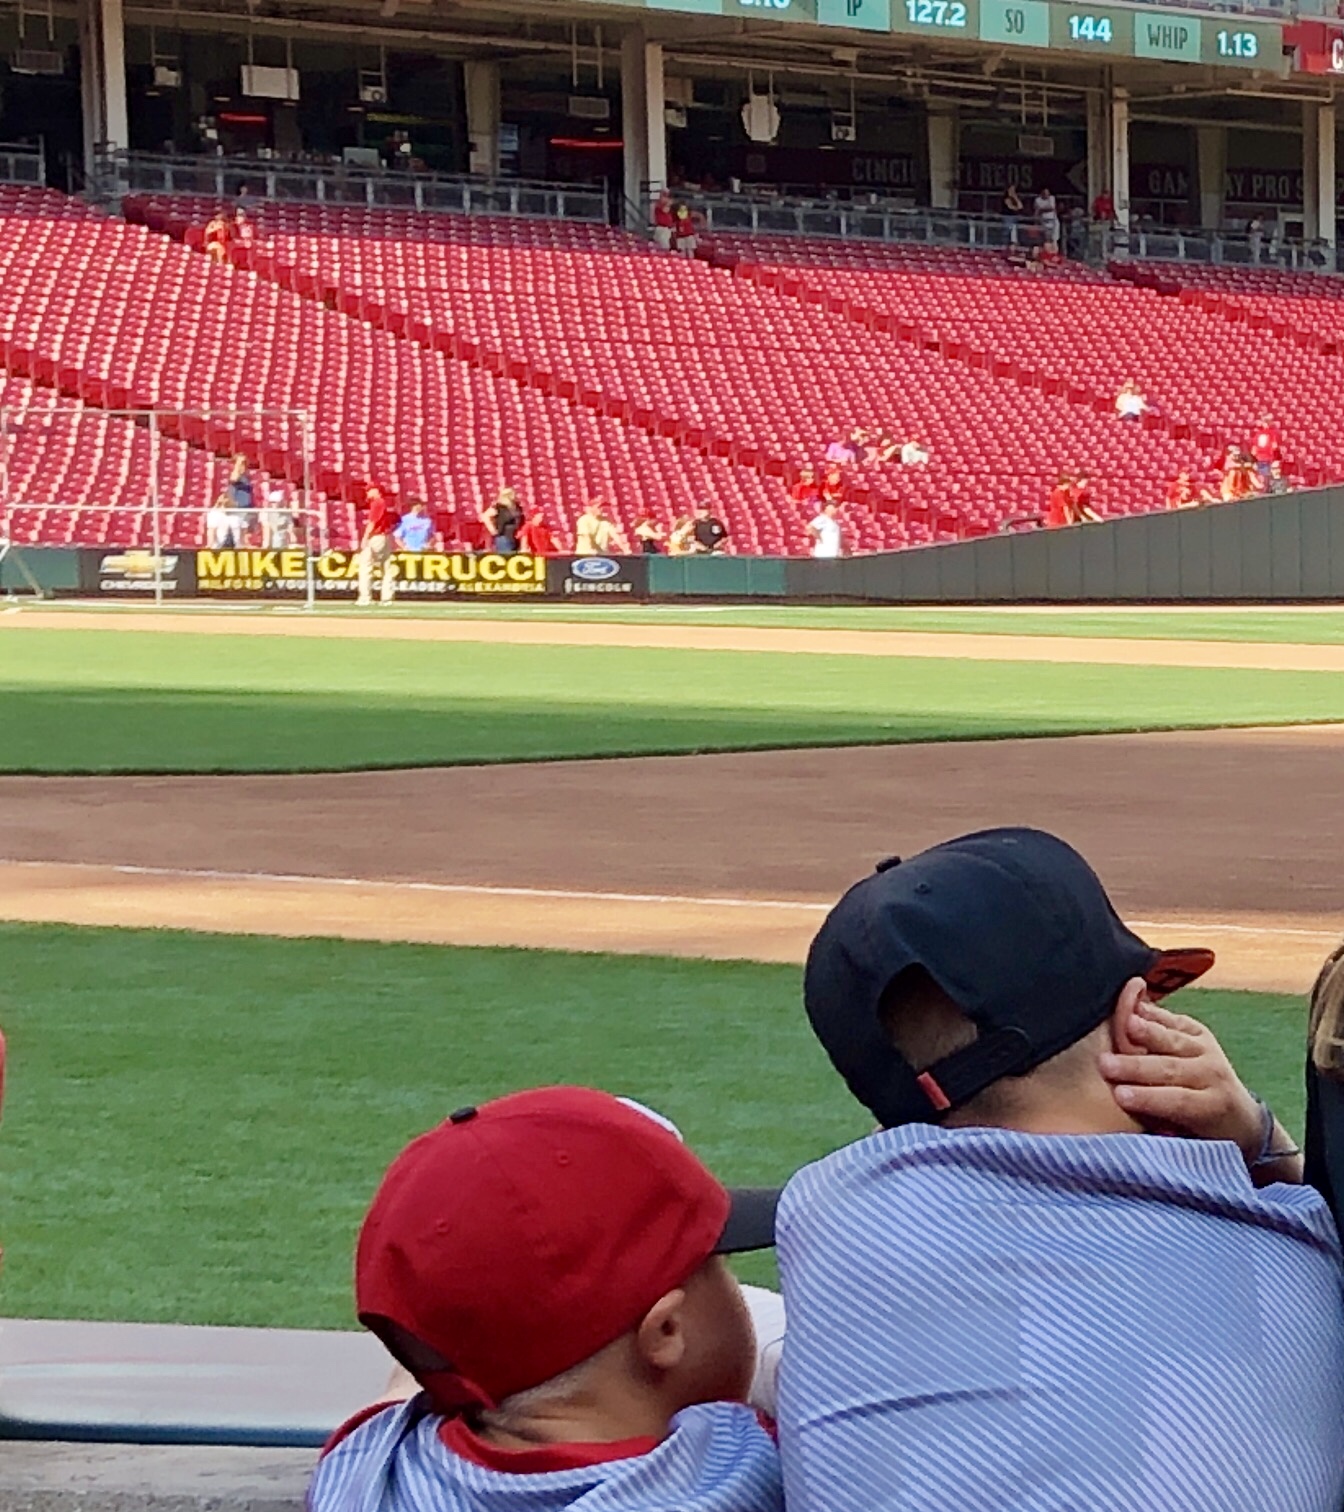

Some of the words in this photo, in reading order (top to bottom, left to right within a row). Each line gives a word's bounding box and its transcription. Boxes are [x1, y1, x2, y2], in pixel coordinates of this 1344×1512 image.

[905, 0, 967, 27] 127.2
[1004, 8, 1025, 34] SO
[1069, 15, 1112, 43] 144
[1147, 23, 1188, 50] WHIP
[1217, 31, 1259, 57] 1.13
[196, 551, 307, 578] MIKE
